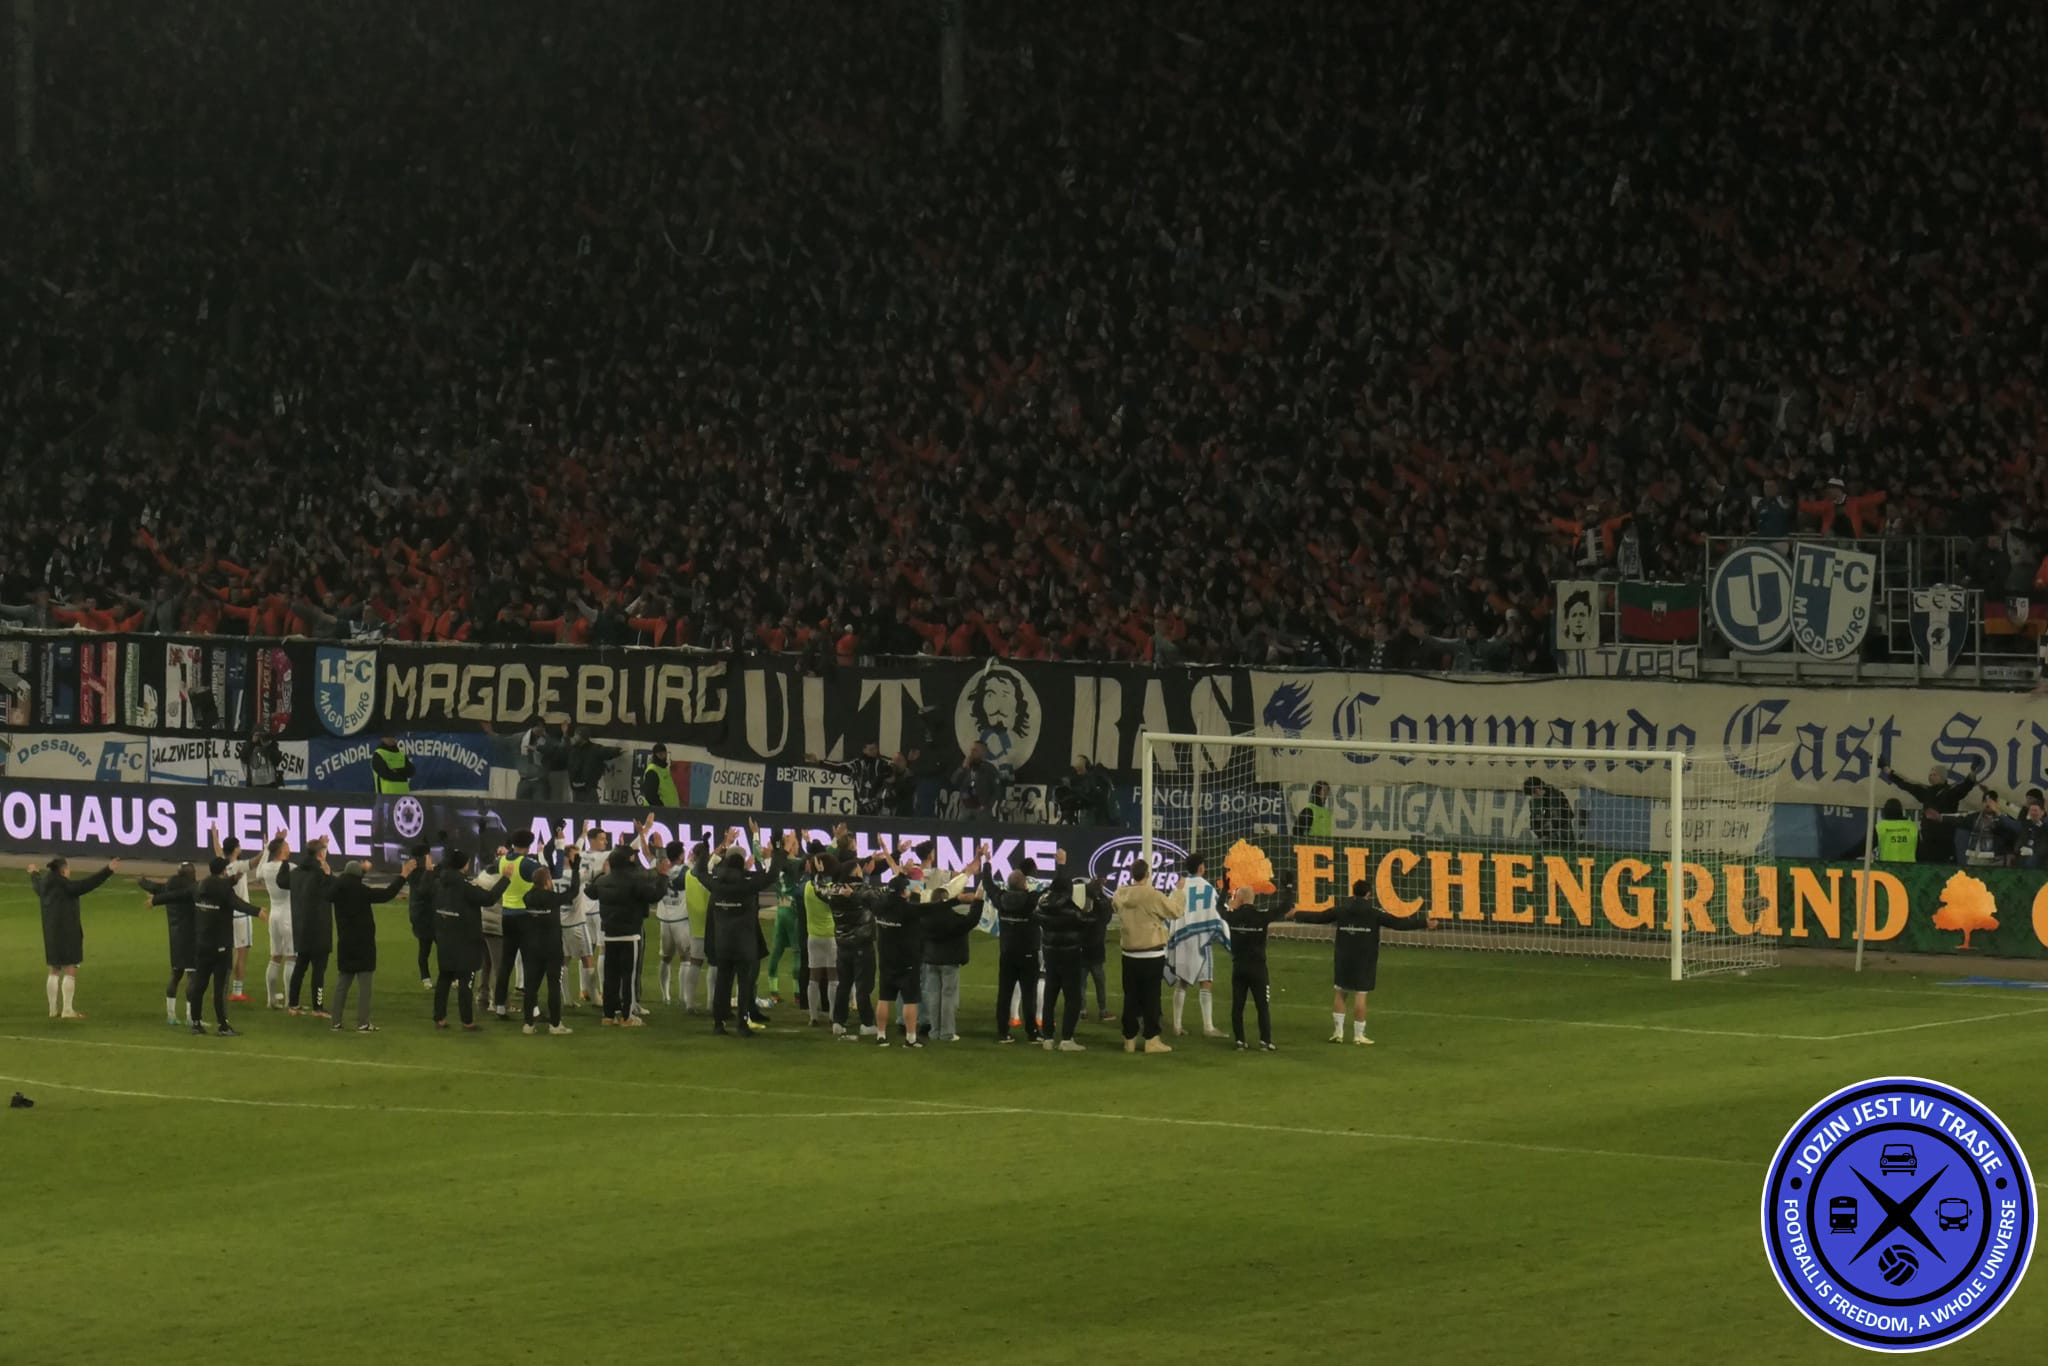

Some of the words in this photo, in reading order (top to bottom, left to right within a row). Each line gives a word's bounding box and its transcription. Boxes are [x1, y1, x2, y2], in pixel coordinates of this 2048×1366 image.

[1798, 554, 1870, 594] 1.FC
[1793, 596, 1866, 655] MAGDEBURG
[320, 658, 373, 684] 1.FC
[319, 689, 370, 729] MAGDEBURG
[384, 664, 728, 726] MAGDEBURG
[16, 738, 92, 769] Dessauer
[223, 740, 231, 760] &
[1333, 691, 1696, 776] Commando
[1724, 699, 1902, 785] East
[314, 743, 373, 781] STENDAL
[396, 738, 488, 777] ANGERMÜNDE
[713, 768, 764, 789] OSCHERS-
[776, 766, 816, 784] BEZIRK
[820, 771, 837, 785] 39
[719, 789, 754, 807] LEBEN
[0, 791, 178, 847] OHAUS
[196, 799, 374, 857] HENKE
[1293, 844, 1910, 942] EICHENGRUND
